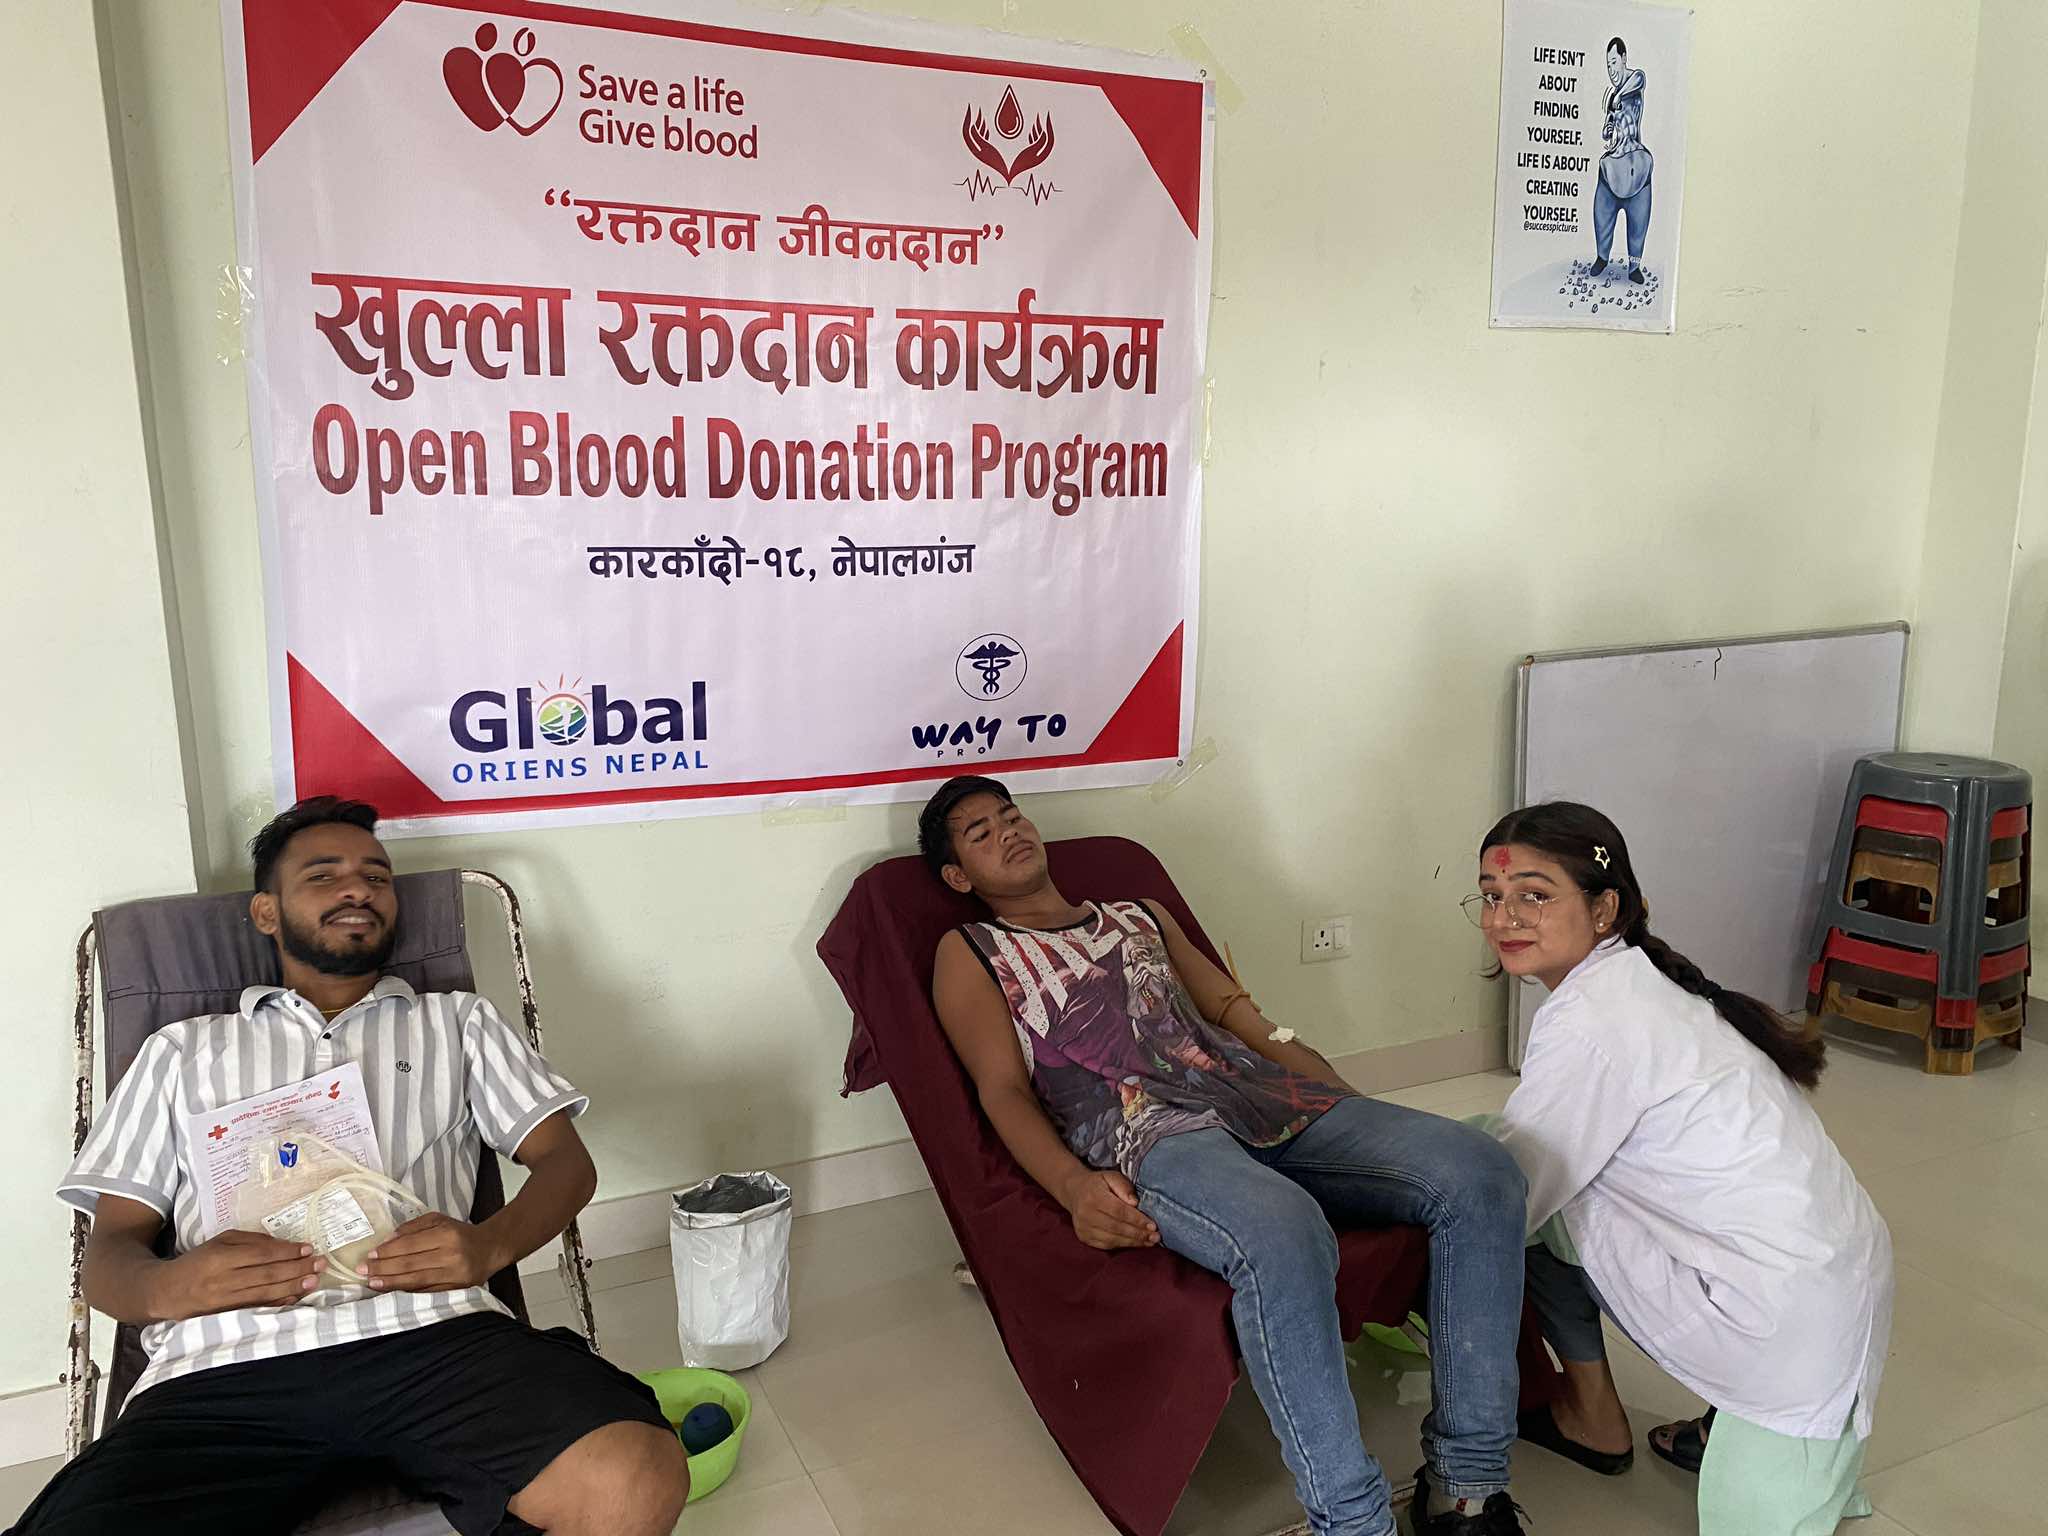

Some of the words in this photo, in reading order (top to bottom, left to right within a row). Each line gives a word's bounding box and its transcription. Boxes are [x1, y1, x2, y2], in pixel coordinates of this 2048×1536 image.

[1534, 47, 1555, 63] LIFE
[1558, 50, 1585, 67] ISN'T
[579, 65, 658, 105] Save
[668, 84, 685, 109] a
[695, 76, 744, 115] life
[1539, 75, 1577, 92] ABOUT
[1534, 101, 1578, 119] FINDING
[580, 109, 655, 148] Give
[664, 115, 758, 158] blood
[1527, 127, 1582, 145] YOURSELF.
[1518, 152, 1538, 168] LIFE
[1542, 155, 1550, 169] IS
[1553, 156, 1590, 172] ABOUT
[1527, 179, 1578, 197] CREATING
[1524, 205, 1578, 222] YOURSELF.
[1524, 221, 1578, 233] @successpictures
[312, 273, 571, 400] खुल्ला
[597, 290, 874, 395] रक्तदान
[896, 288, 1164, 398] कार्यक्रम
[313, 404, 487, 515] Open
[510, 411, 686, 498] Blood
[707, 418, 953, 501] Donation
[972, 424, 1167, 516] Program
[831, 536, 976, 577] नेपालगंज
[912, 716, 1002, 749] WAY
[1018, 714, 1066, 743] TO
[453, 757, 587, 783] ORIENS
[607, 751, 708, 774] NEPAL
